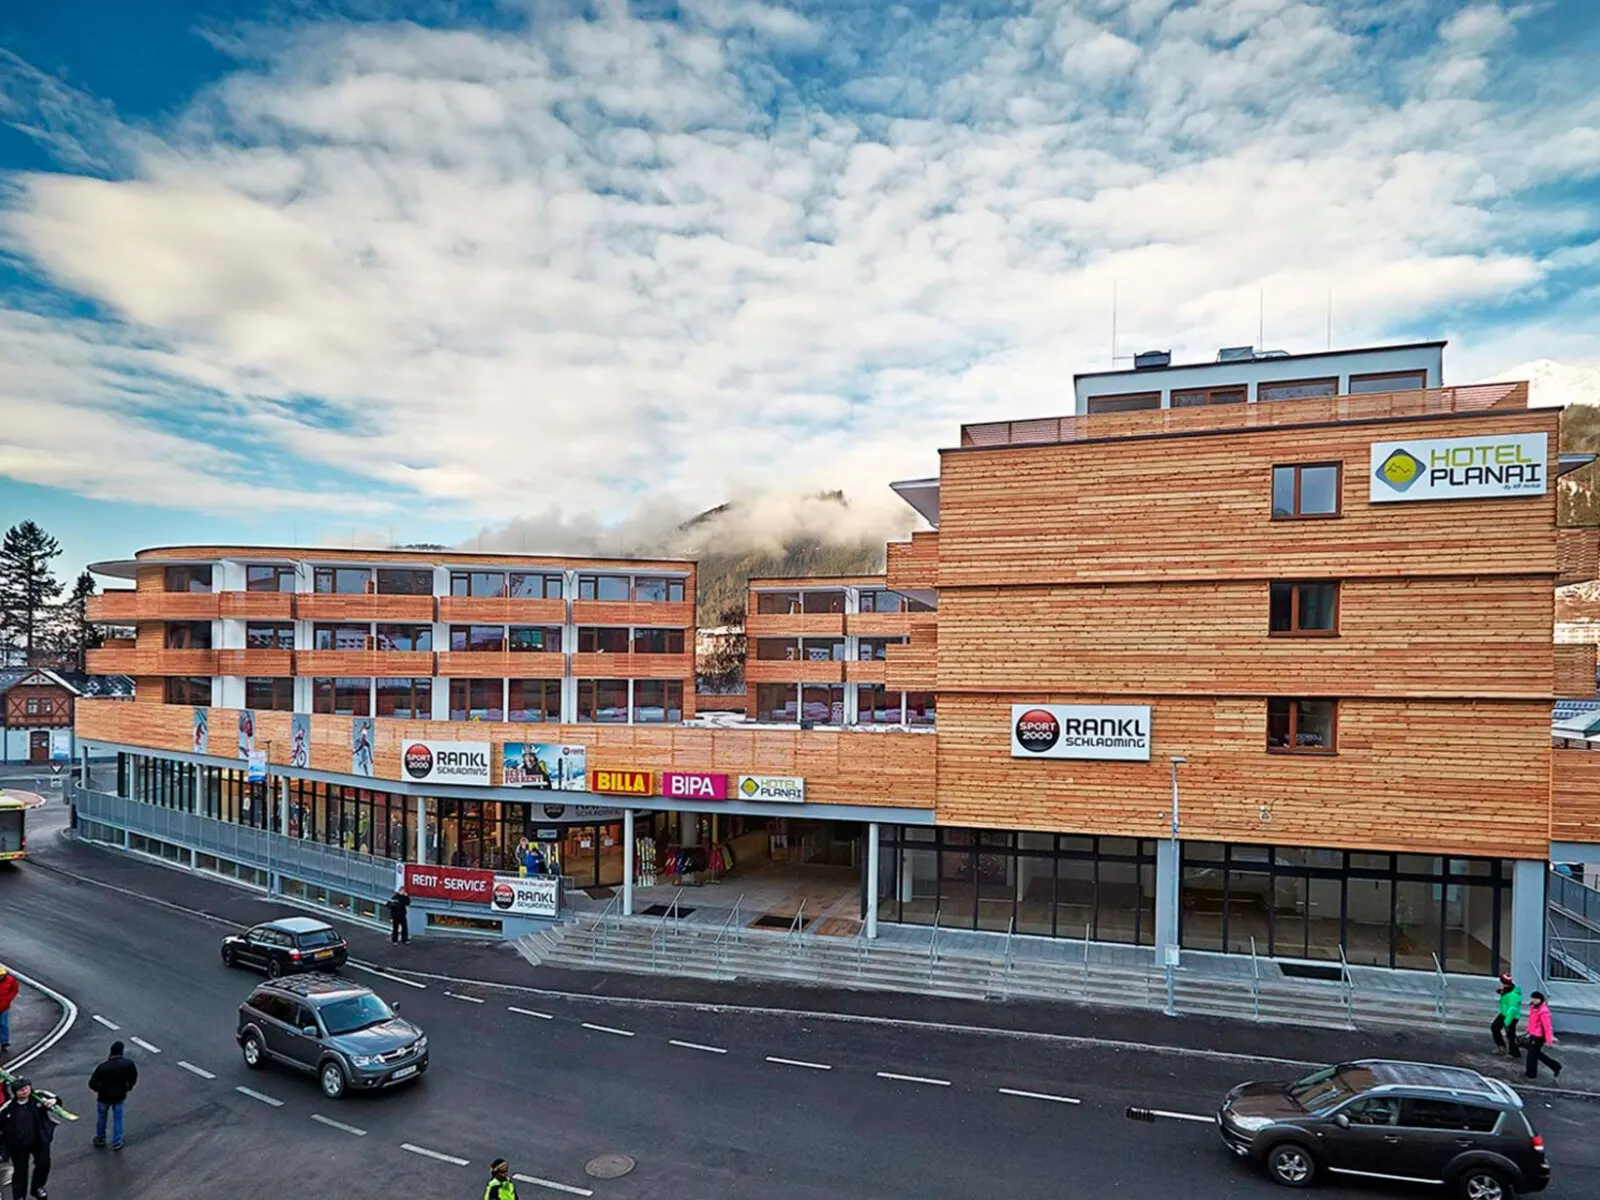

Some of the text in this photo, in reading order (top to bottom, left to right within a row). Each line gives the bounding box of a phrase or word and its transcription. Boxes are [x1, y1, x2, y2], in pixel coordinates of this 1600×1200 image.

[1431, 444, 1532, 467] HOTEL
[1430, 463, 1542, 487] PLANAI
[1019, 721, 1056, 731] SPORT
[1066, 718, 1146, 737] RANKL
[1022, 731, 1053, 740] 2000
[1065, 736, 1146, 748] SCHLADMING
[406, 753, 431, 762] SPORT
[437, 751, 488, 767] RANKL
[408, 761, 429, 769] 2000
[436, 767, 488, 777] SCHLADMING
[597, 772, 646, 792] BILLA
[671, 775, 715, 797] BIPA
[760, 778, 798, 789] HOTEL
[760, 788, 802, 798] PLANAI
[412, 873, 438, 888] RENT
[443, 877, 487, 892] SERVICE
[517, 890, 555, 903] RANKL
